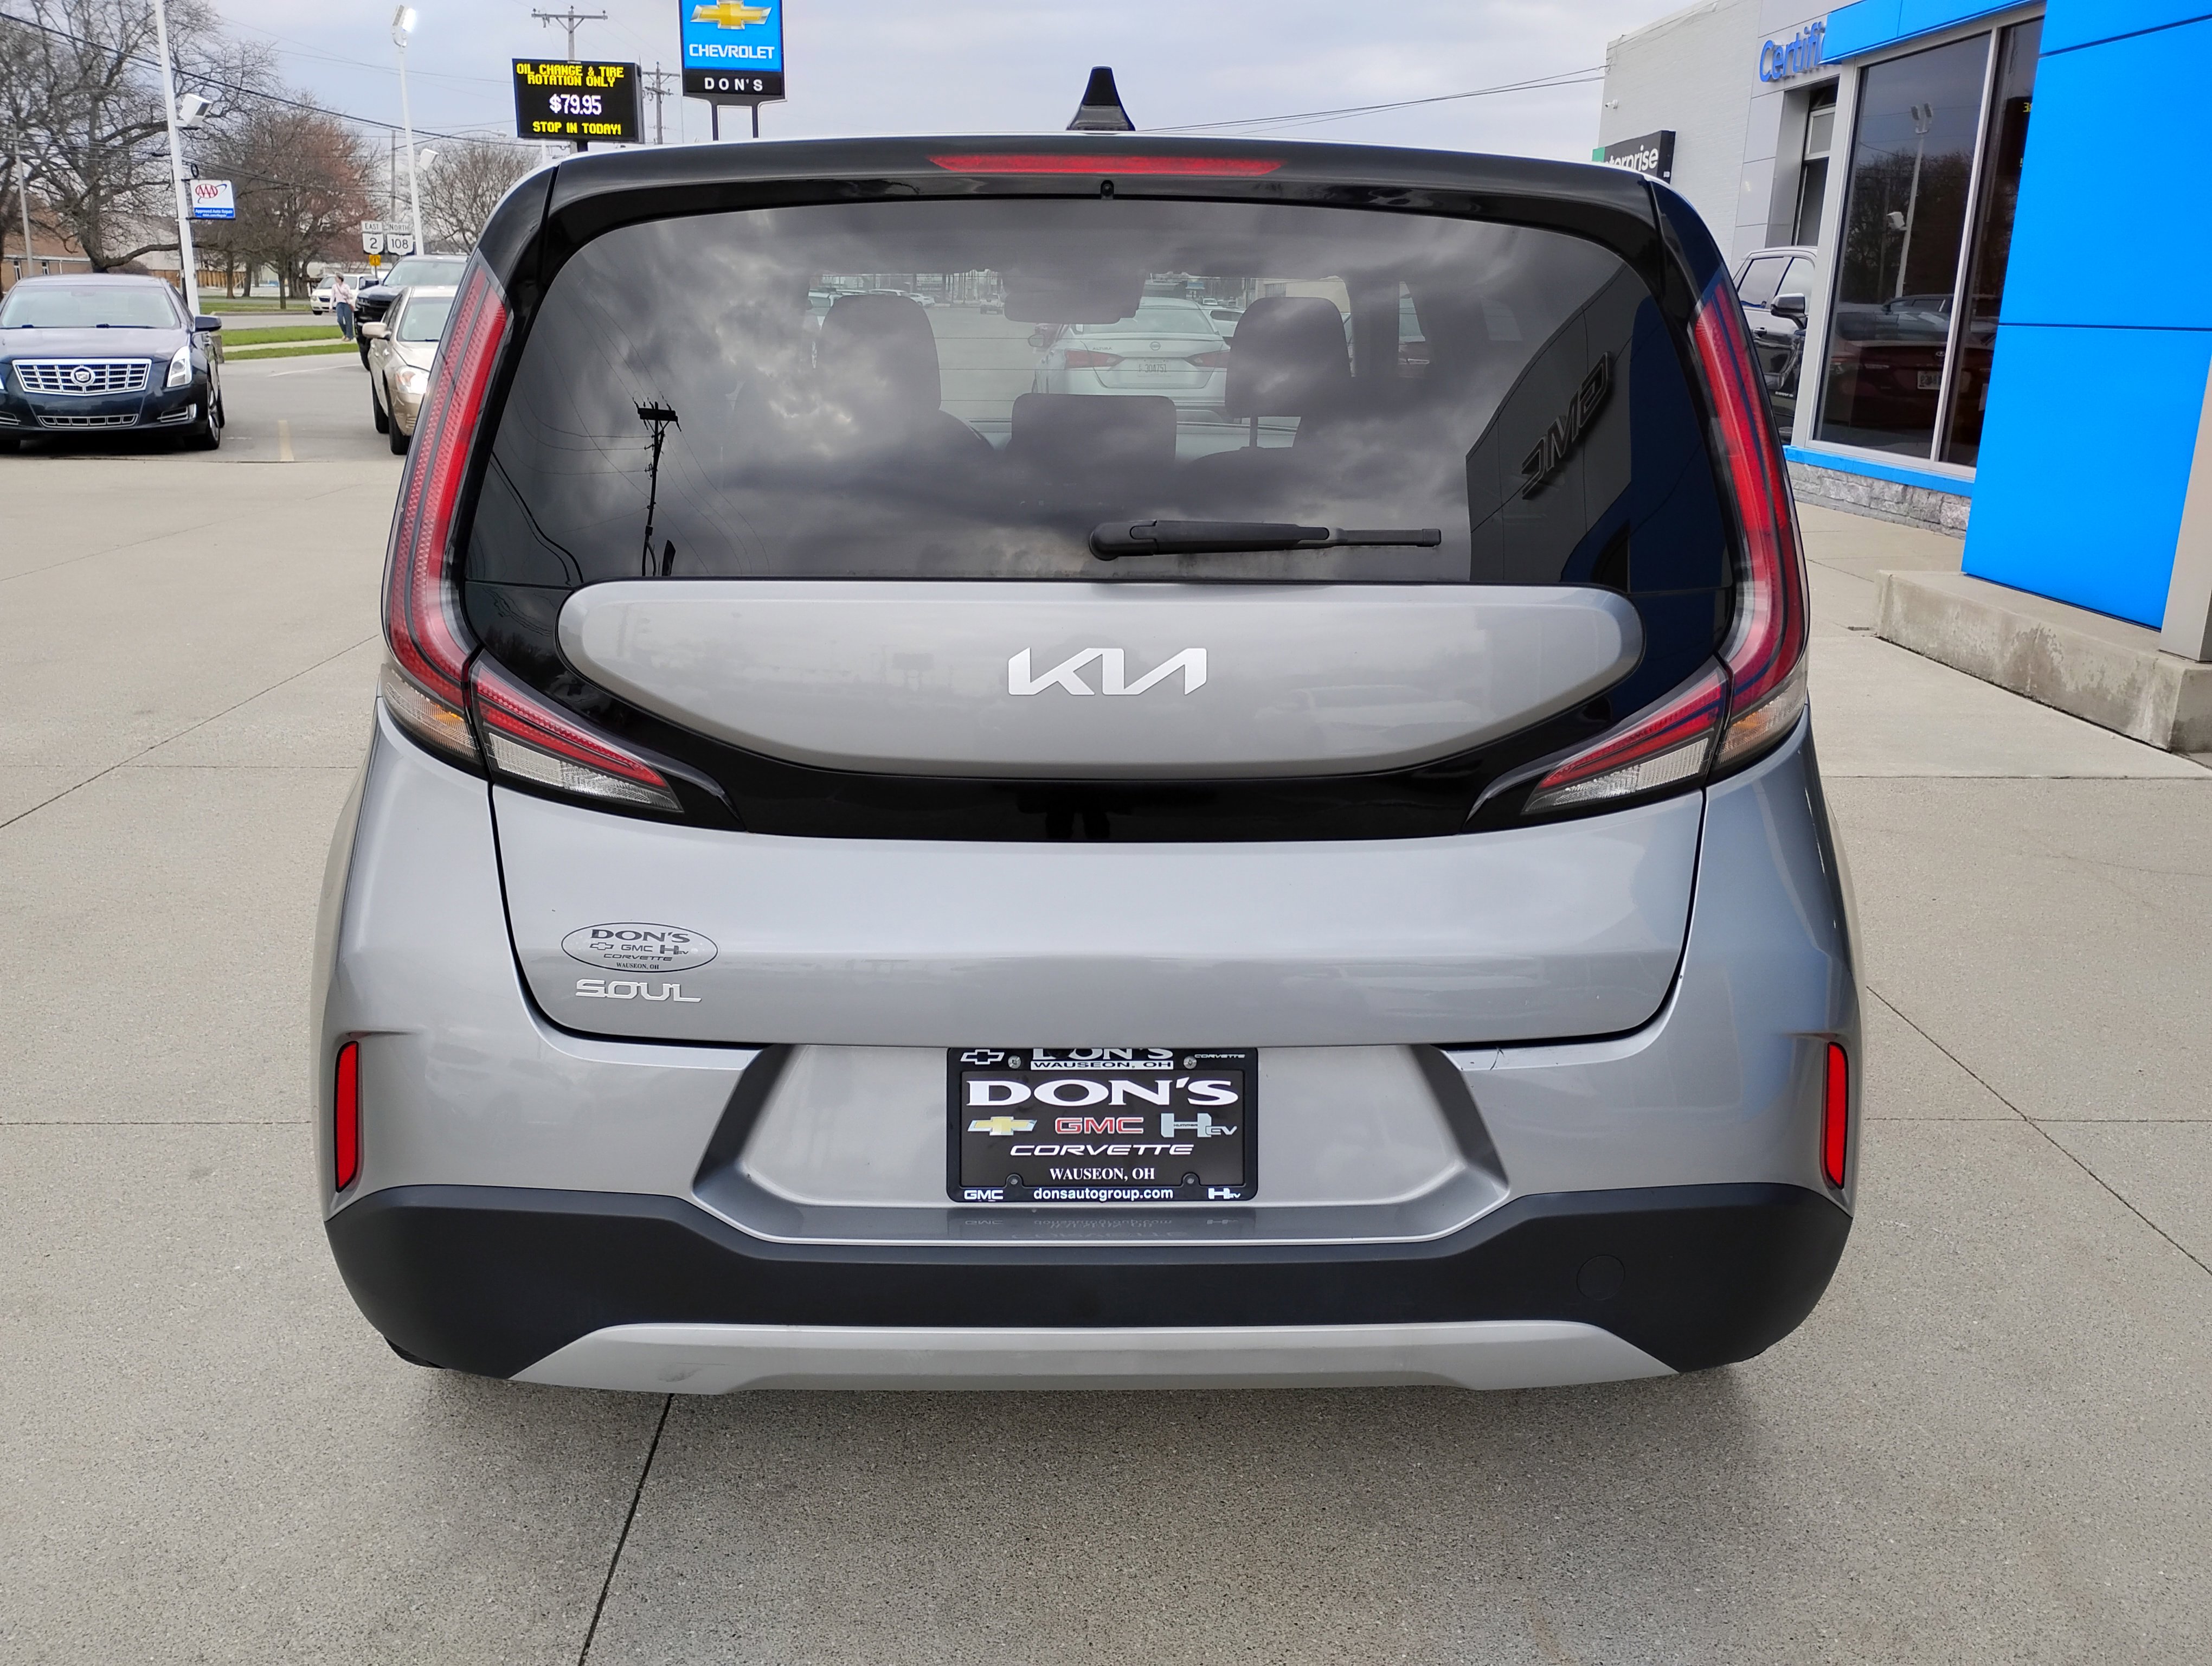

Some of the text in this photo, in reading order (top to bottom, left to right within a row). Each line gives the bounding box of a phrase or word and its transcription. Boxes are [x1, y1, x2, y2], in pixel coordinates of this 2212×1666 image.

[689, 43, 775, 59] CHEVROLET
[1759, 21, 1825, 82] Certifi
[516, 63, 624, 78] OIL CHANGE & TIRE
[528, 74, 616, 87] ROTATION ONLY
[704, 77, 763, 92] DON'S
[549, 93, 602, 115] $79.95
[532, 121, 621, 135] STOP IN TODAY!
[196, 184, 217, 198] AAA
[370, 238, 378, 249] 2
[391, 239, 408, 249] 108
[1008, 646, 1207, 696] KIA
[590, 929, 691, 943] DON'S
[621, 944, 653, 952] GMC
[603, 953, 673, 962] CORVETTE
[575, 978, 702, 1003] SOUL
[1033, 1048, 1173, 1060] ONS
[966, 1077, 1239, 1106] DON'S
[1054, 1117, 1144, 1135] GMC
[1010, 1144, 1194, 1156] CORVETTE
[1050, 1168, 1155, 1182] WAUSEON, OH
[964, 1189, 1004, 1200] GMC
[1033, 1188, 1173, 1201] donsautogroup.com
